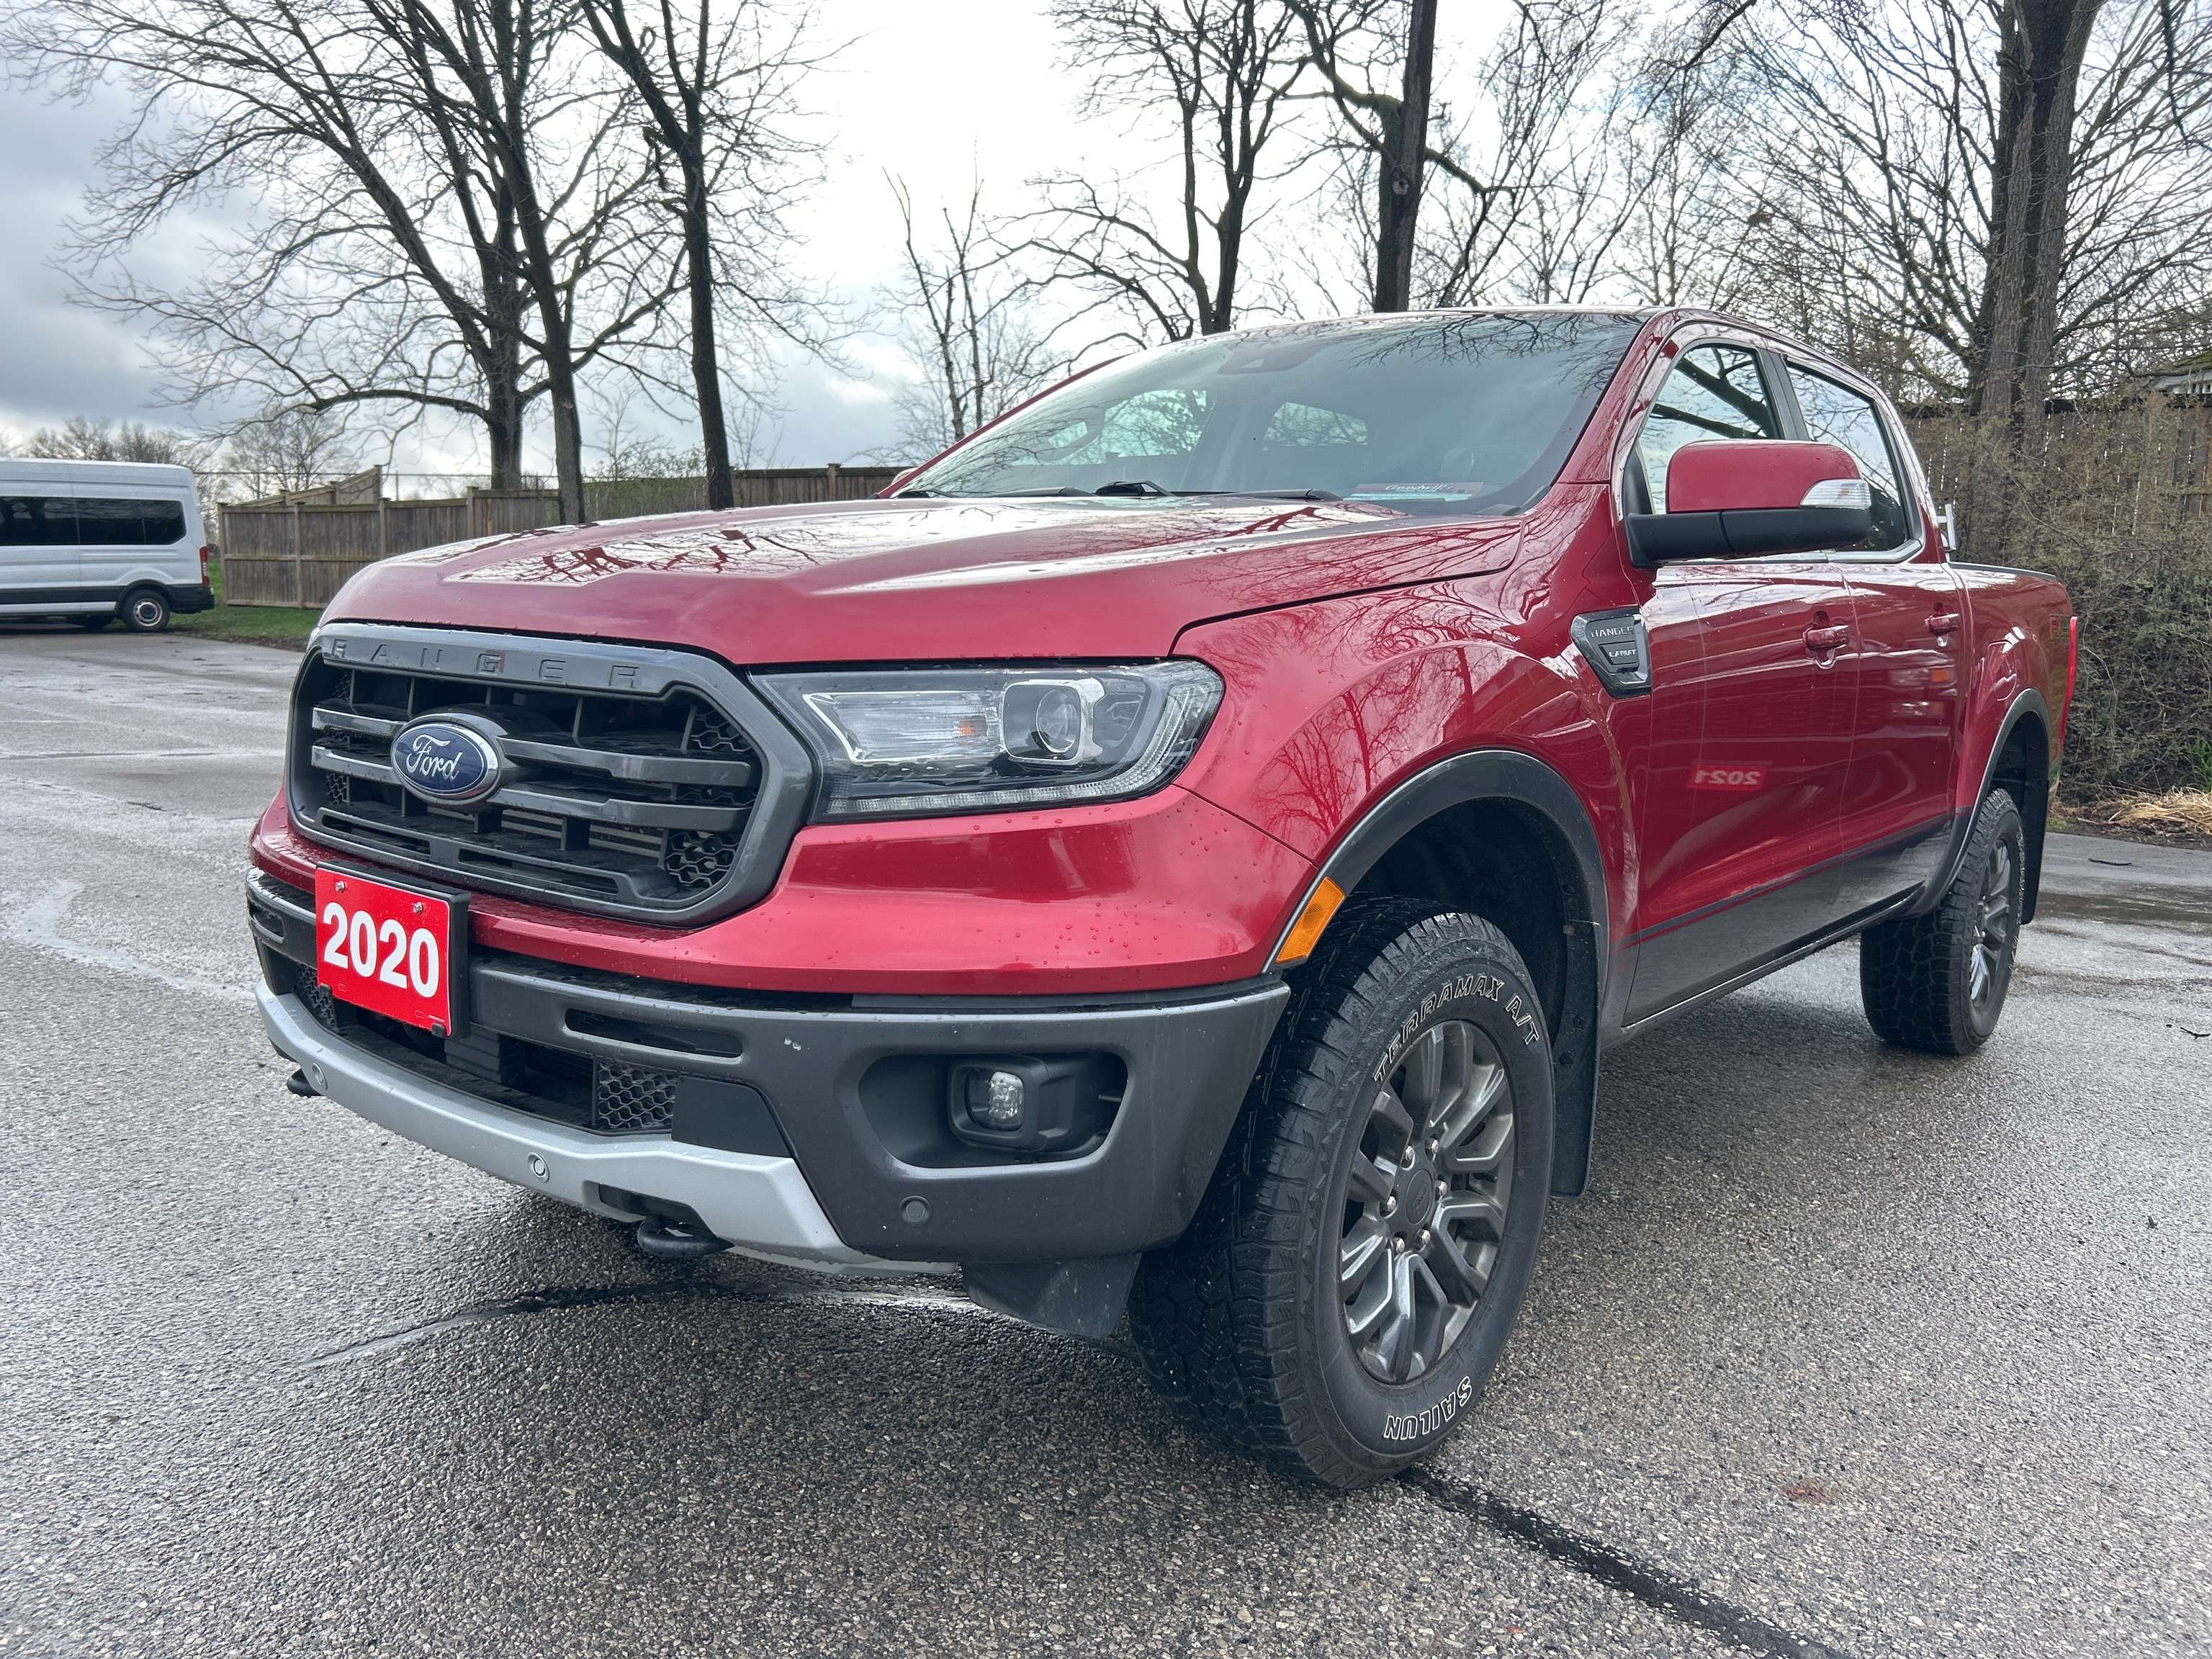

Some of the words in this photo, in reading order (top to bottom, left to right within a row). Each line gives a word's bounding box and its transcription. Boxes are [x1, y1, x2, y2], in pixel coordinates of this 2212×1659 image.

[1591, 626, 1634, 638] RANGER
[331, 637, 640, 689] RANGER
[405, 734, 463, 781] Ford
[323, 901, 440, 999] 2020
[1373, 973, 1505, 1082] TERRAMAX
[1506, 994, 1539, 1046] A/T
[1383, 1375, 1473, 1440] SAILUN
